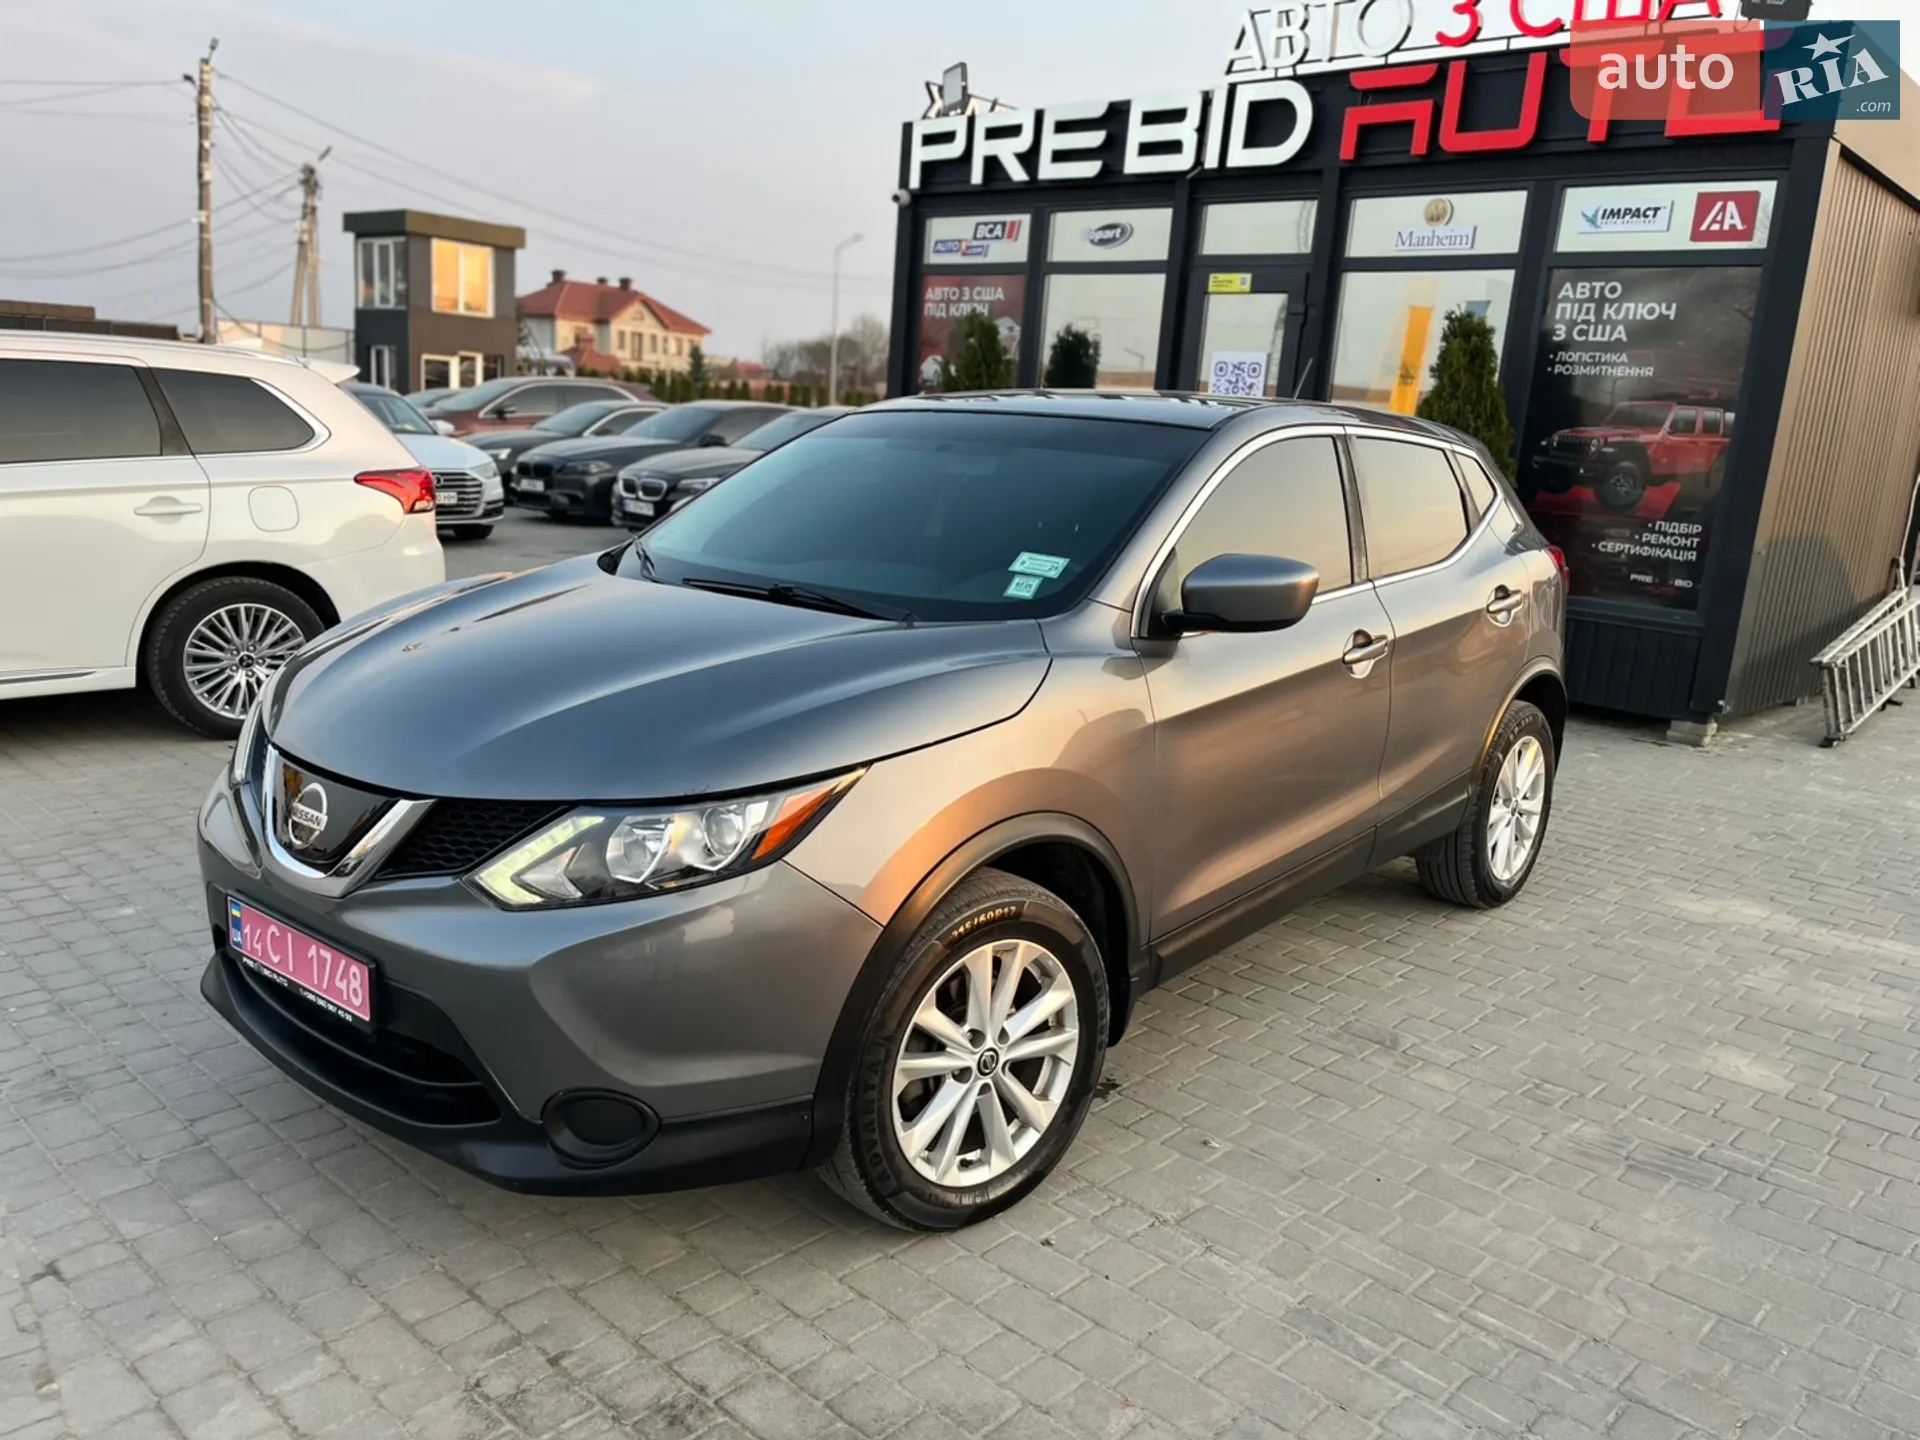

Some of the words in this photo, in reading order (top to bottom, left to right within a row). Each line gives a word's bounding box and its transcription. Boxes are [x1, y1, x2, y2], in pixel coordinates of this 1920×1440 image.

[1225, 0, 1414, 75] АВТО
[909, 101, 1112, 190] PRE
[1124, 80, 1313, 175] BID
[1601, 206, 1661, 220] IMPACT
[975, 223, 1003, 240] BCA
[1395, 229, 1470, 248] Manheim
[925, 286, 960, 300] АВТО
[972, 286, 1005, 300] США
[1557, 281, 1623, 299] АВТО
[924, 303, 946, 318] ПІД
[1555, 303, 1596, 322] ПІД
[1602, 303, 1677, 320] КЛЮЧ
[1552, 324, 1567, 341] З
[1572, 324, 1628, 342] США
[1555, 351, 1628, 363] ЛОГІСТИКА
[1554, 364, 1654, 377] РОЗМИТНЕННЯ
[1655, 520, 1702, 535] ПІДБІР
[1642, 532, 1700, 548] РЕМОНТ
[1598, 541, 1697, 562] СЕРТИФІКАЦІЯ
[293, 806, 321, 827] SSAN
[307, 943, 363, 1007] 1748
